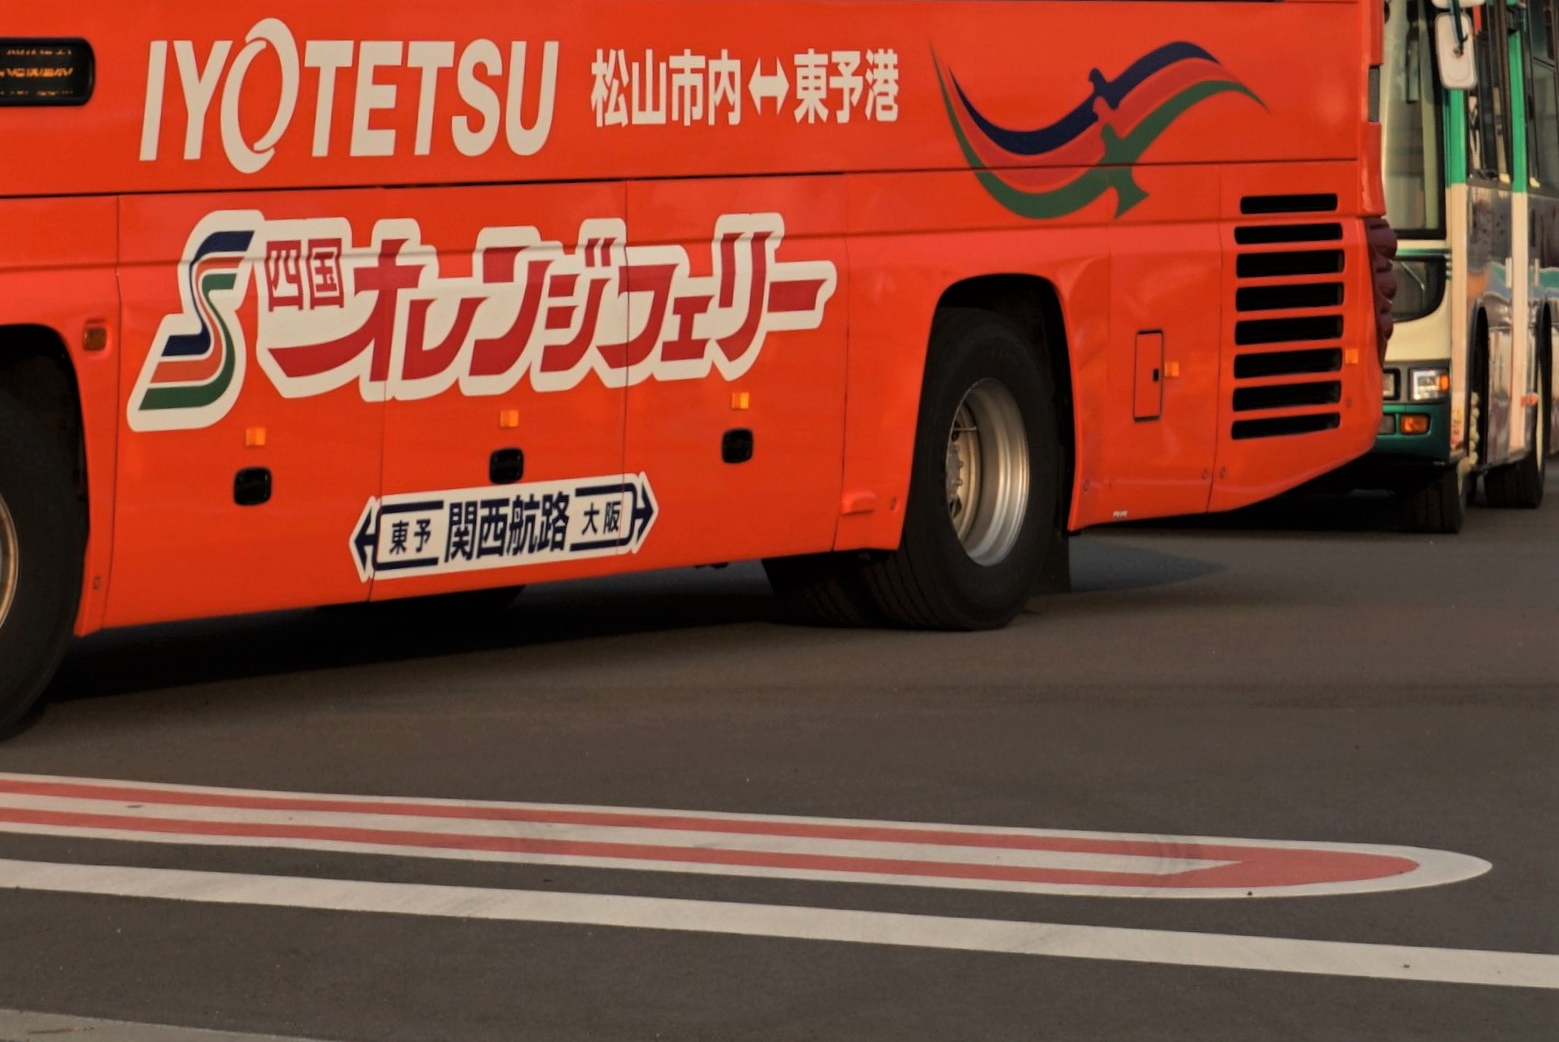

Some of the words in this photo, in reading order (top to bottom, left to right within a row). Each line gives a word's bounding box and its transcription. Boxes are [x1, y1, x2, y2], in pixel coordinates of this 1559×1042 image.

[139, 17, 560, 175] IYOTETSU
[591, 48, 741, 128] 松山市内
[793, 47, 900, 124] 東予港
[268, 237, 343, 312] 四国
[268, 231, 828, 382] オレンジフェリー
[389, 518, 432, 555] 東予
[443, 491, 570, 564] 関西航路
[581, 500, 622, 536] 大阪
